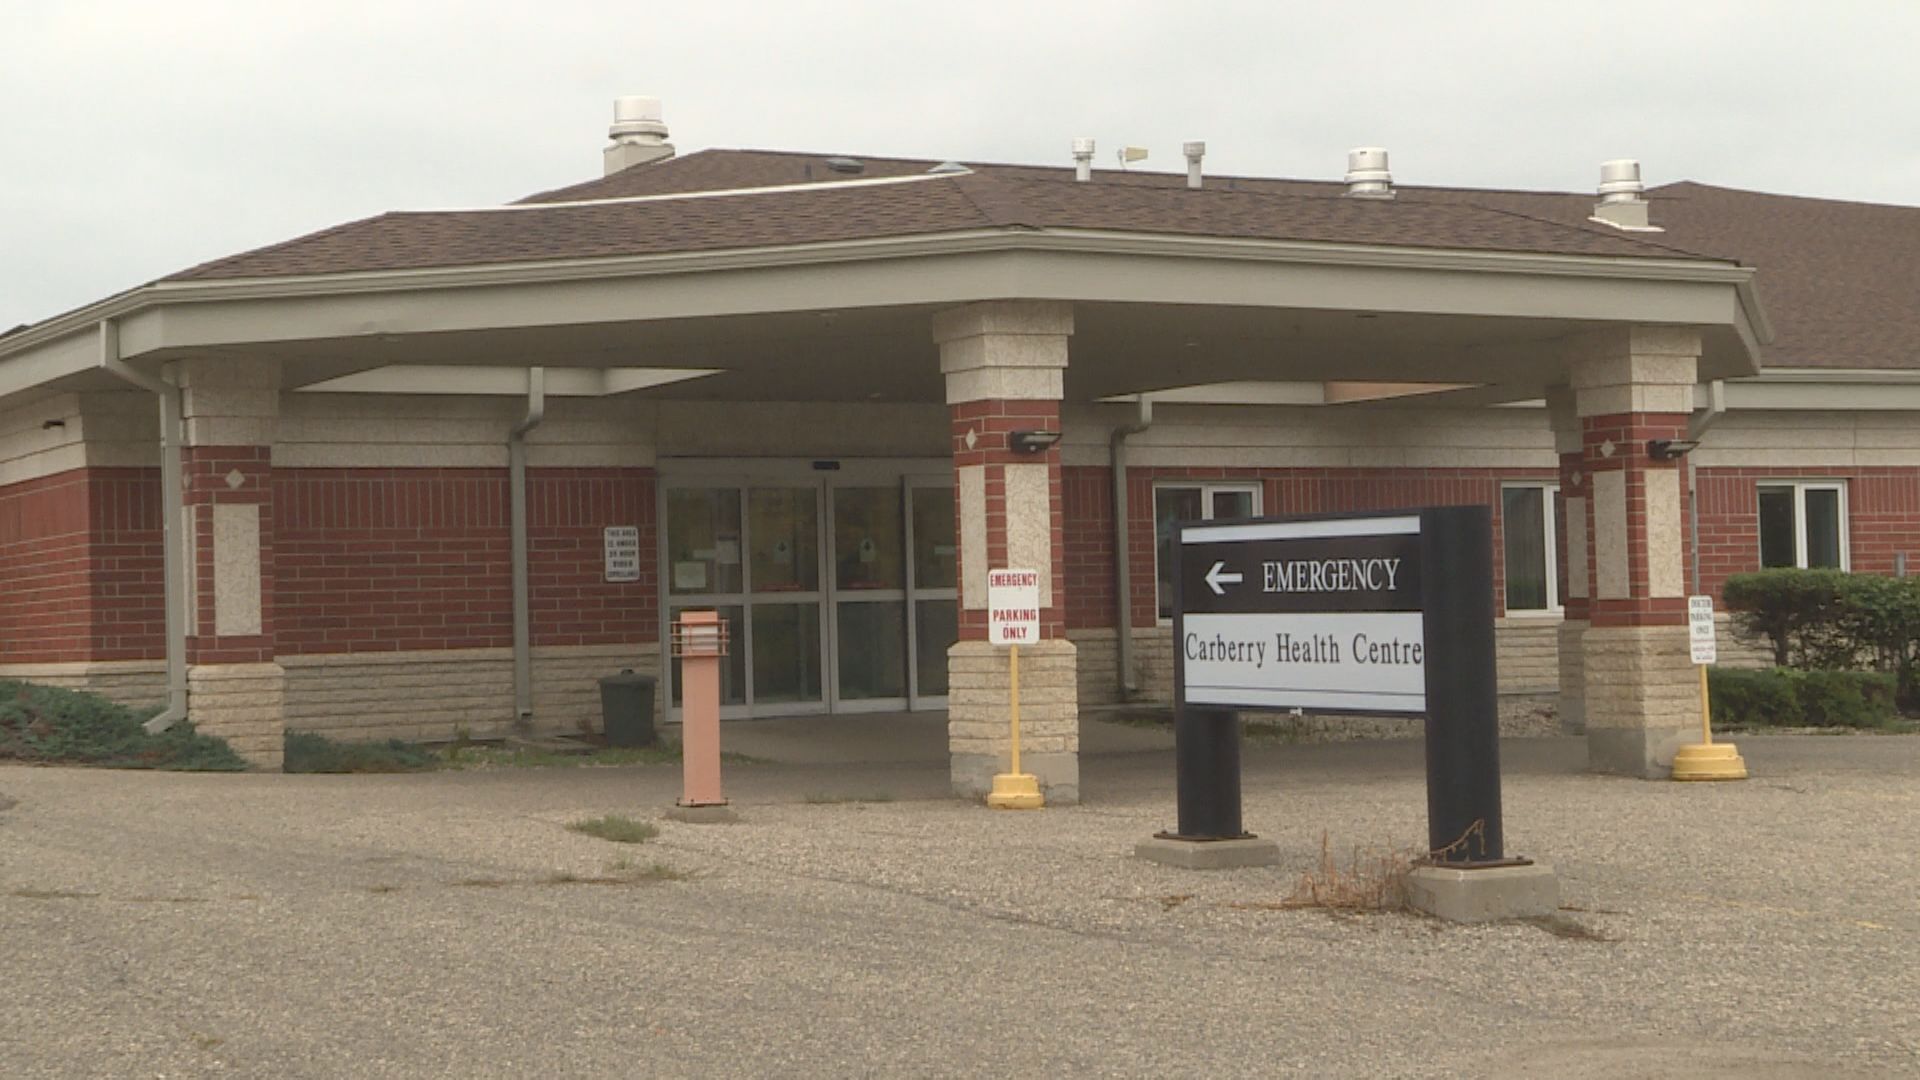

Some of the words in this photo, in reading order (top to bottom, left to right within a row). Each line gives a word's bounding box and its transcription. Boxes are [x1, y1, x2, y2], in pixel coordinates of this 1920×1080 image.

[990, 574, 1037, 587] EMERGENCY
[1262, 559, 1400, 592] EMERGENCY
[993, 609, 1036, 621] PARKING
[1003, 627, 1027, 639] ONLY
[1185, 632, 1266, 669] Carberry
[1276, 633, 1340, 663] Health
[1352, 633, 1423, 664] Centre
